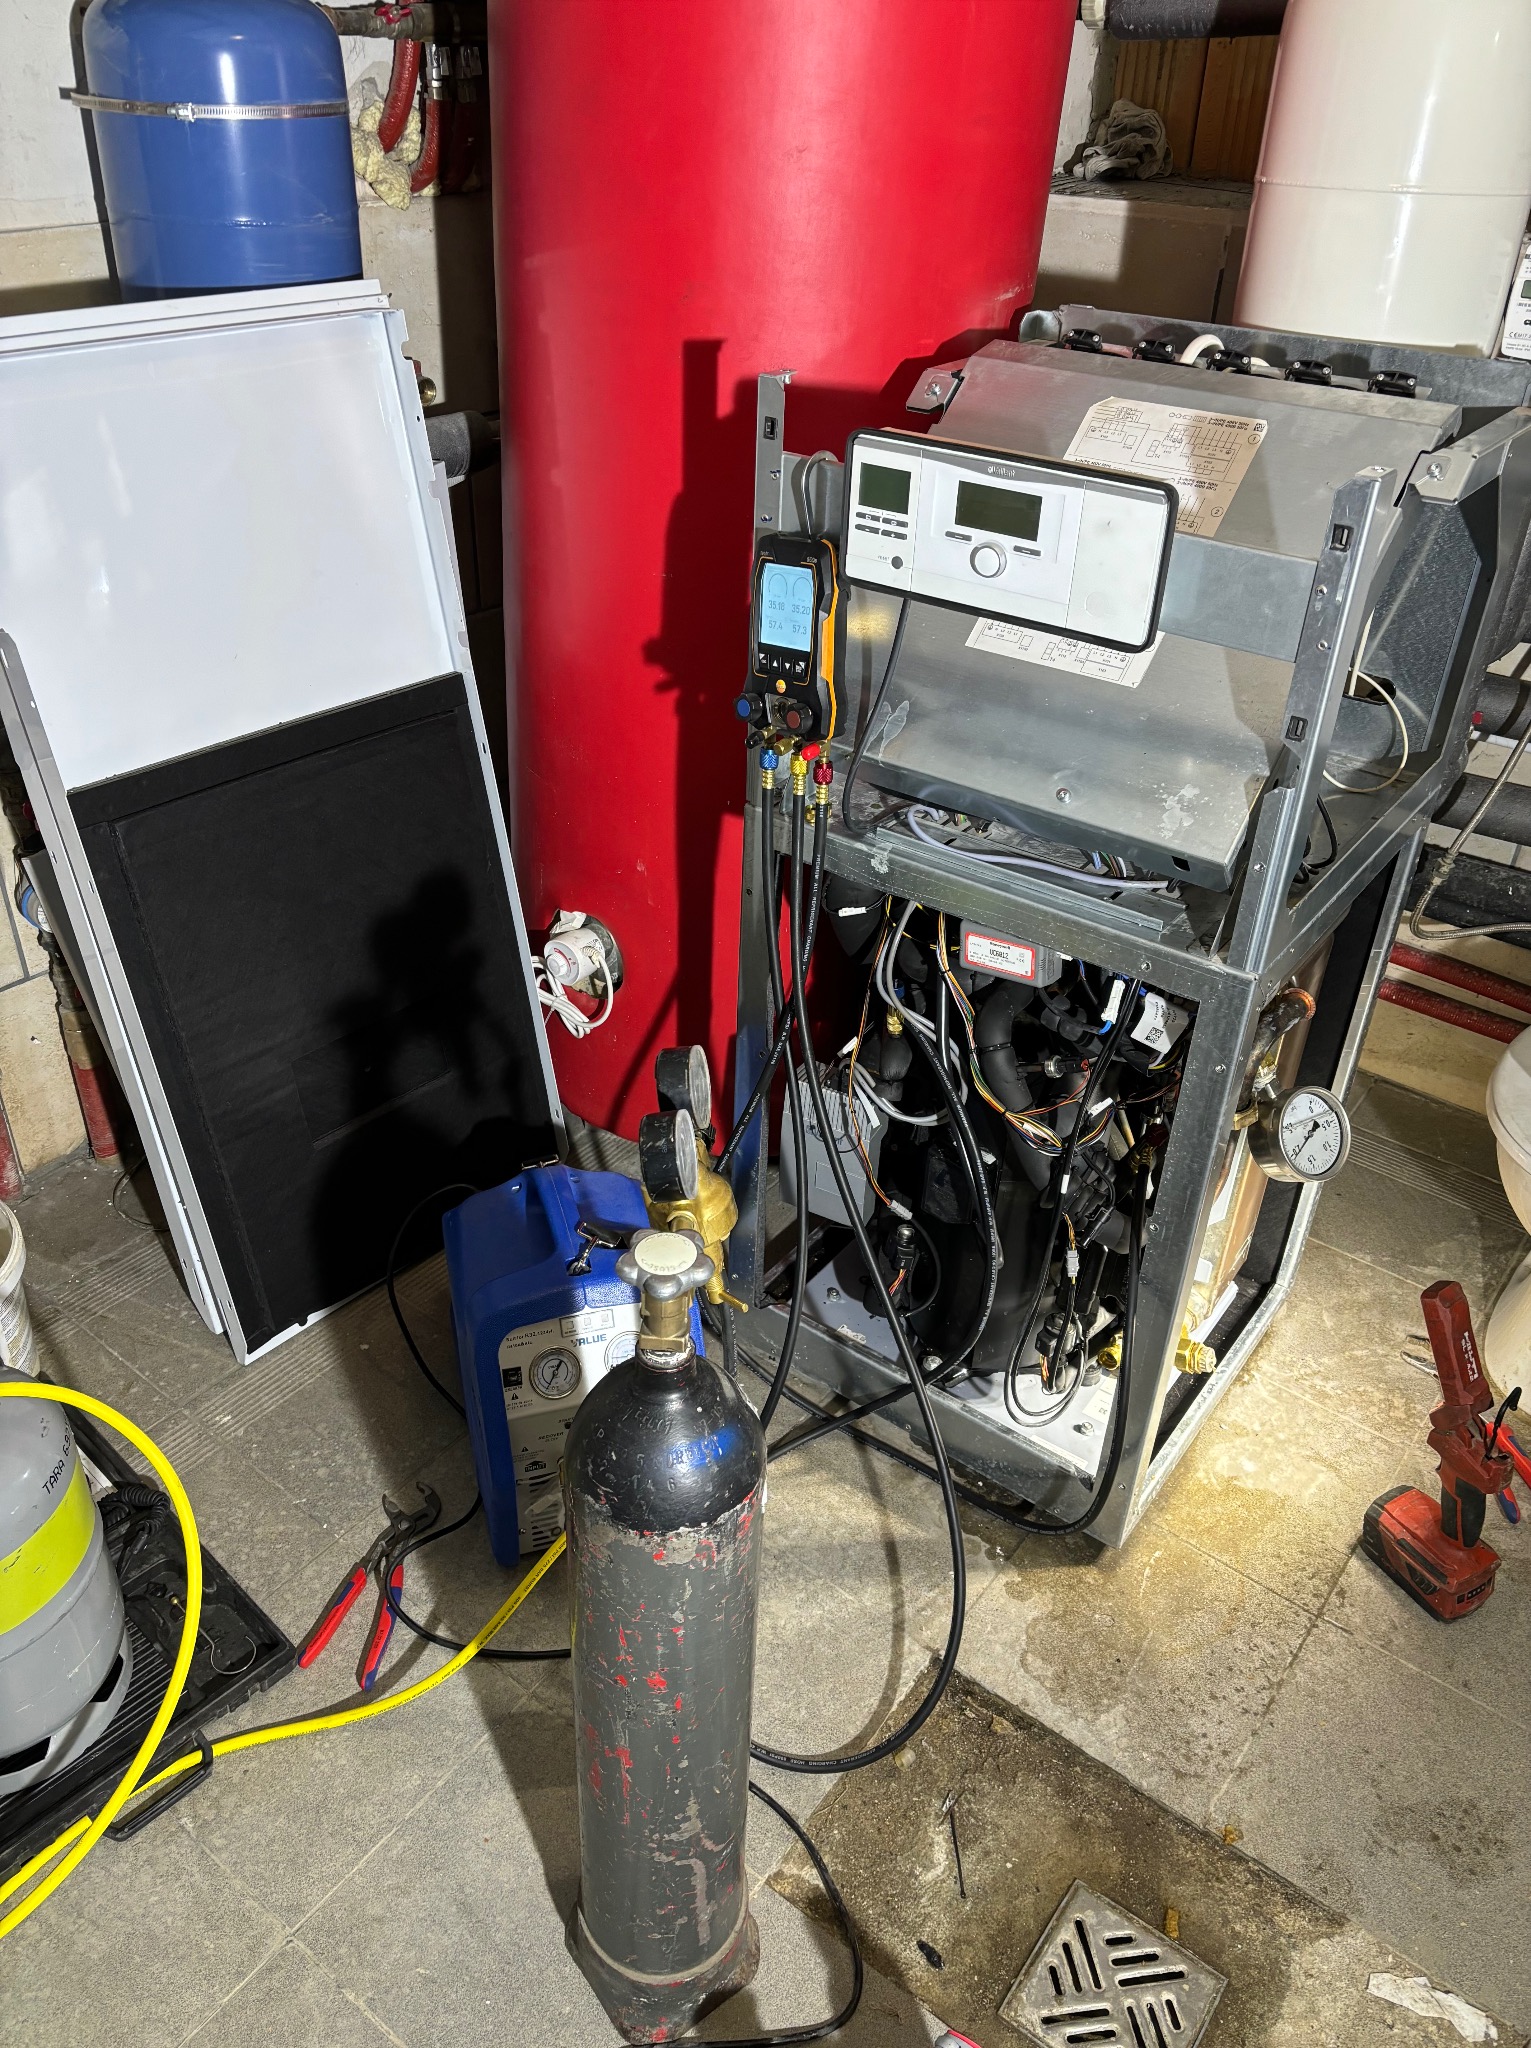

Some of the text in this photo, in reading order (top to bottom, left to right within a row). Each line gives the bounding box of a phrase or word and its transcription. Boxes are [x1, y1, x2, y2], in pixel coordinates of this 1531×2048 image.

[791, 603, 811, 616] 35.20
[768, 619, 807, 635] 57.4 57.3
[570, 1333, 608, 1347] VALUE
[42, 1459, 65, 1495] TARA
